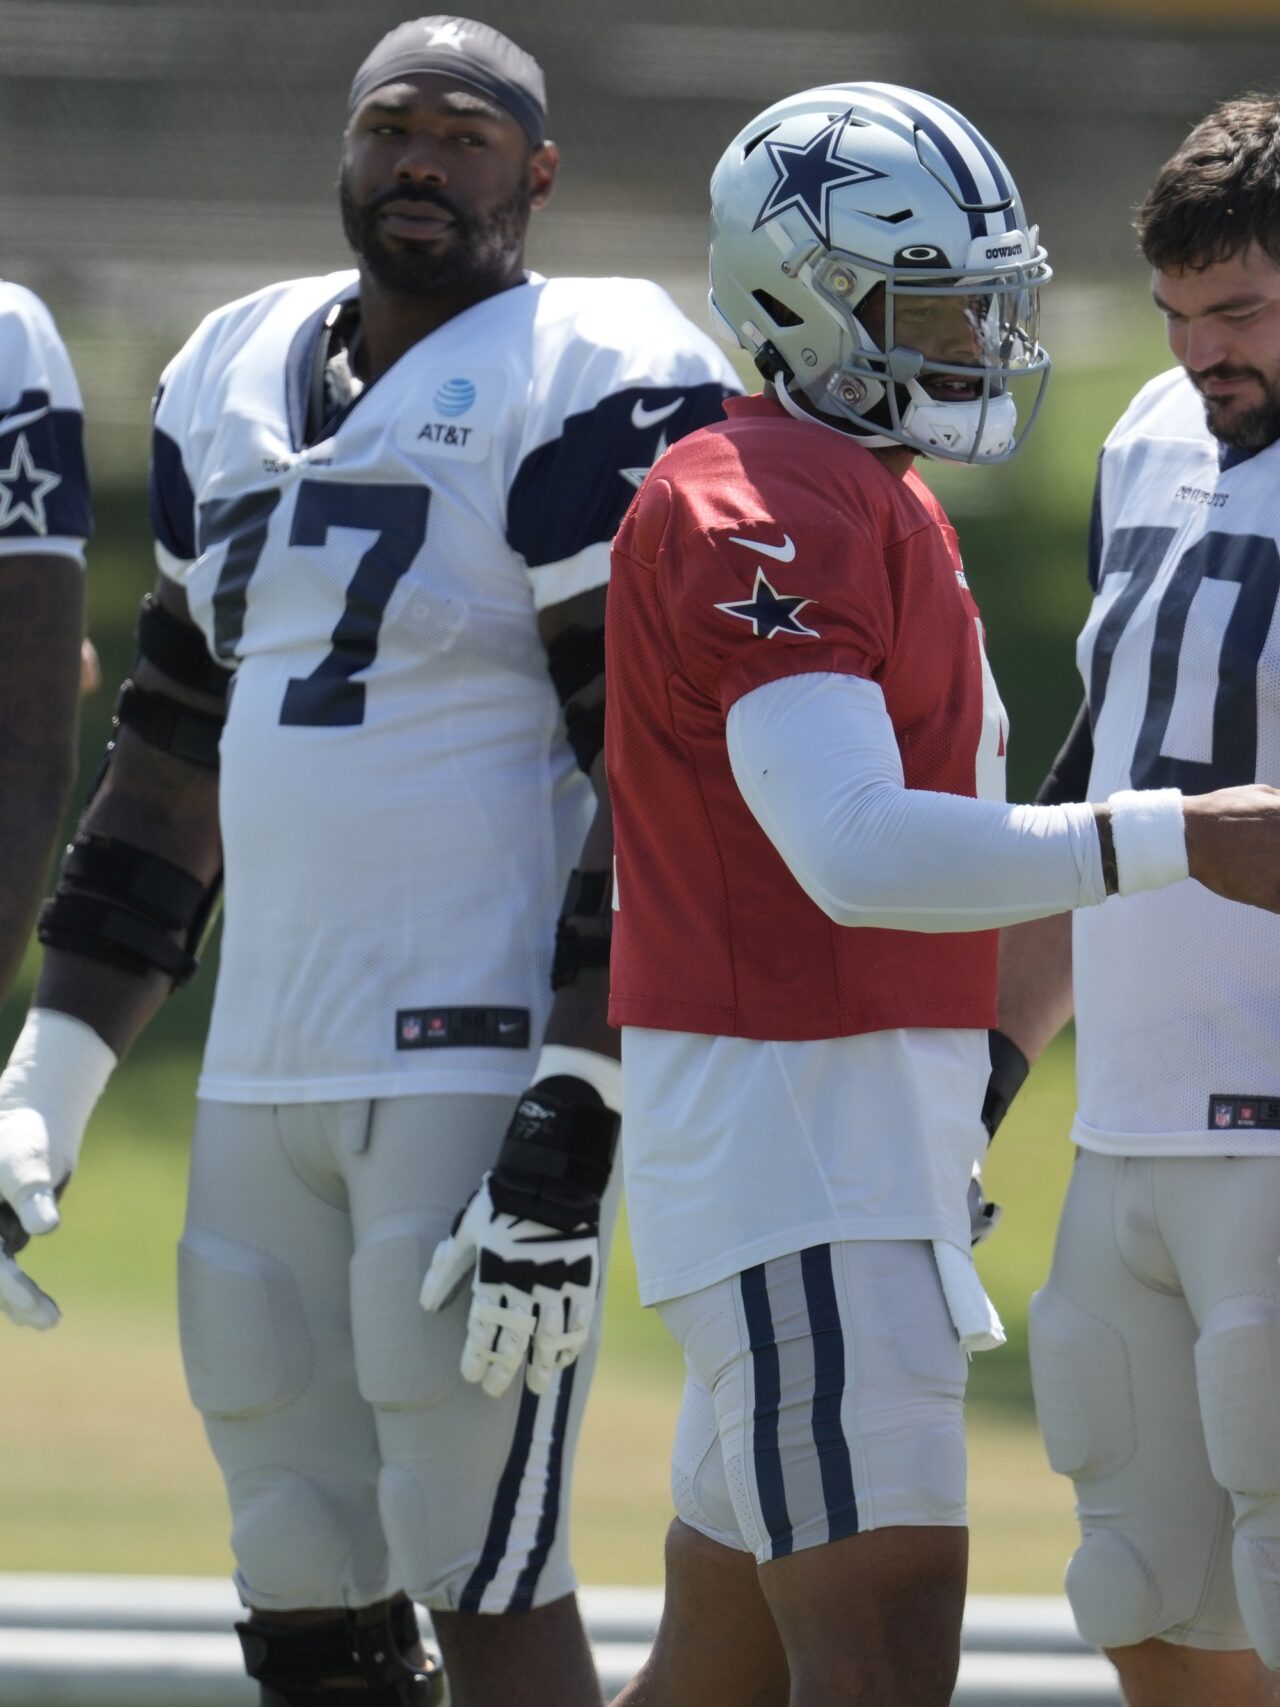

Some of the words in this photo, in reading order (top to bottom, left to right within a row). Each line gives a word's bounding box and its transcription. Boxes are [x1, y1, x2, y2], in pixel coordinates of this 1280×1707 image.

[985, 243, 1023, 260] COWBOYS
[417, 423, 473, 447] AT&T
[197, 478, 432, 727] 77
